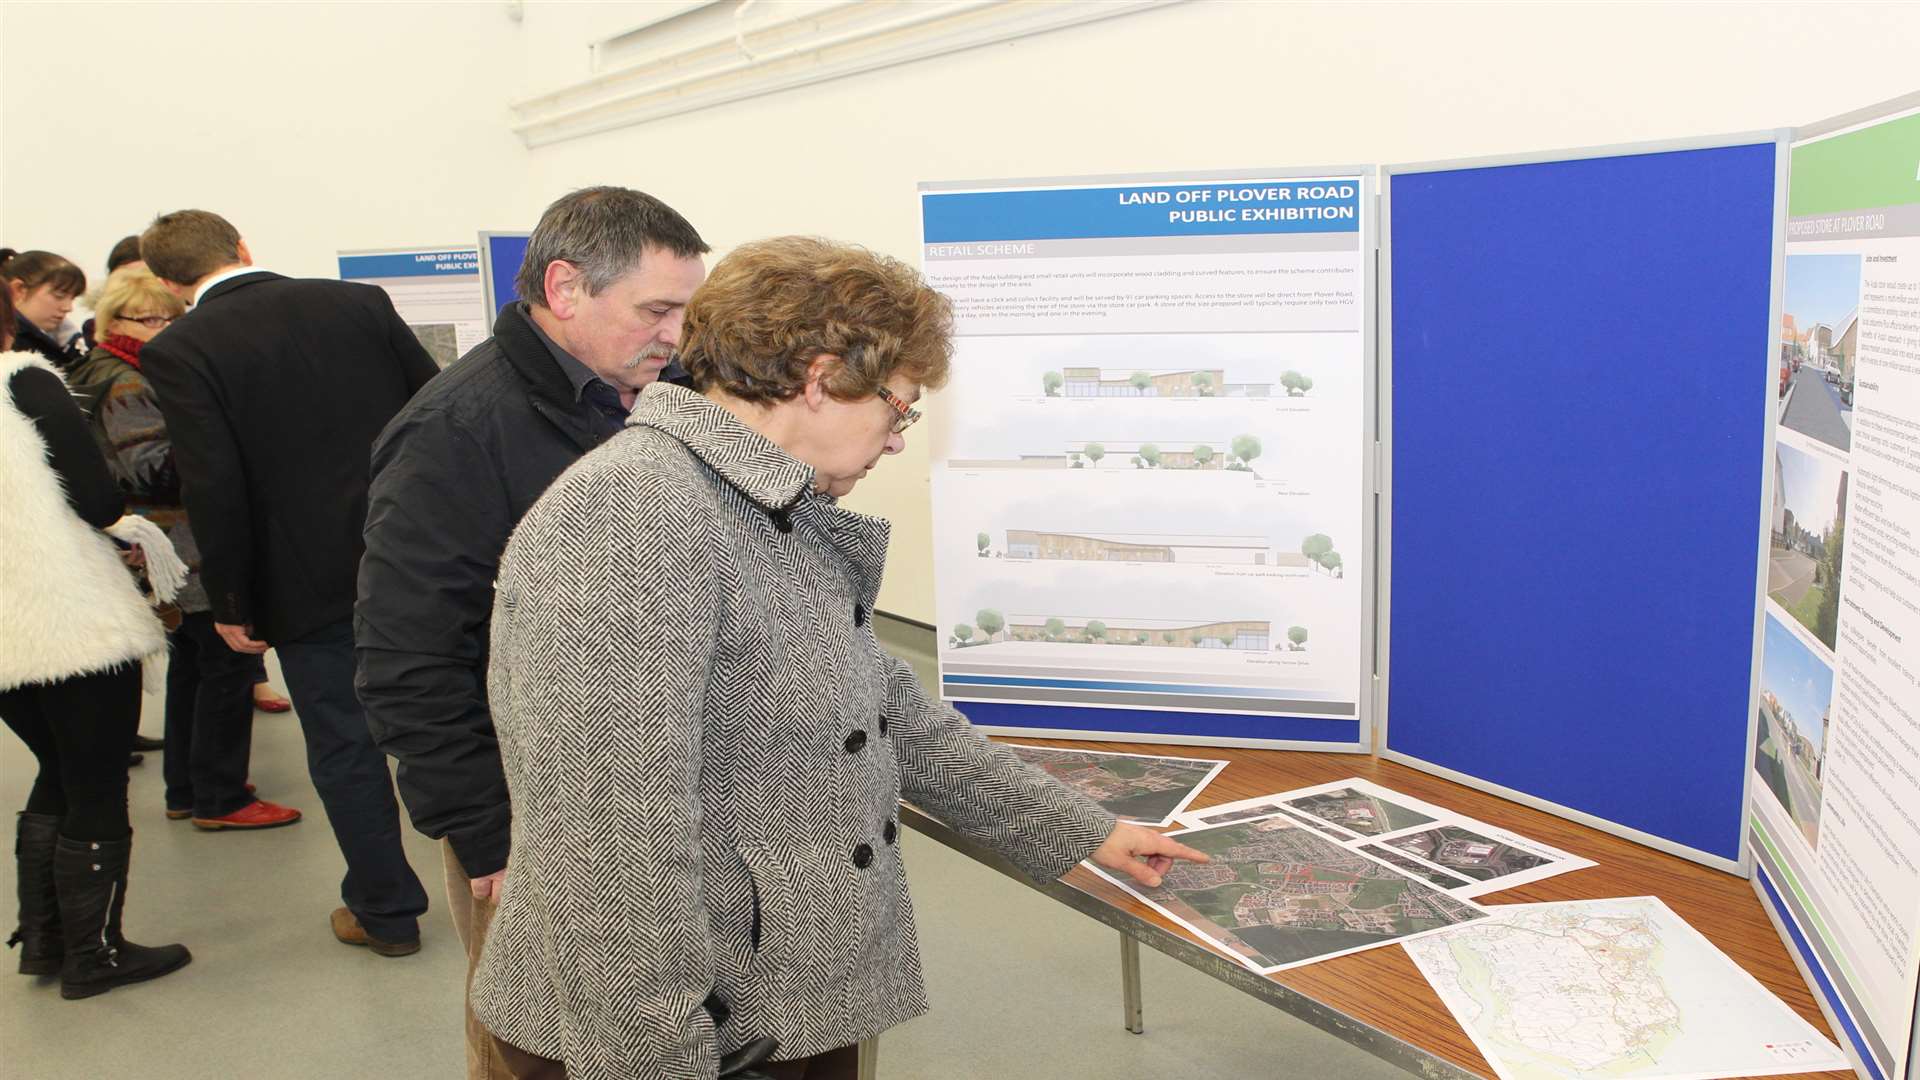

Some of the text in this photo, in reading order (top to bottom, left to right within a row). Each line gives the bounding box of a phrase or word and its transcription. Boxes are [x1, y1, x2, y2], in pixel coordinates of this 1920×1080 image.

[1119, 186, 1354, 205] LAND OFF PLOVER ROAD
[1169, 206, 1353, 223] PUBLIC EXHIBITION
[1815, 218, 1832, 234] STORE
[1832, 217, 1840, 233] AT
[1841, 215, 1865, 232] PLOVER
[1865, 214, 1885, 230] ROAD
[453, 252, 478, 260] PLOVE
[929, 242, 1035, 257] RETAIL SCHEME
[435, 262, 463, 270] PUBLIC
